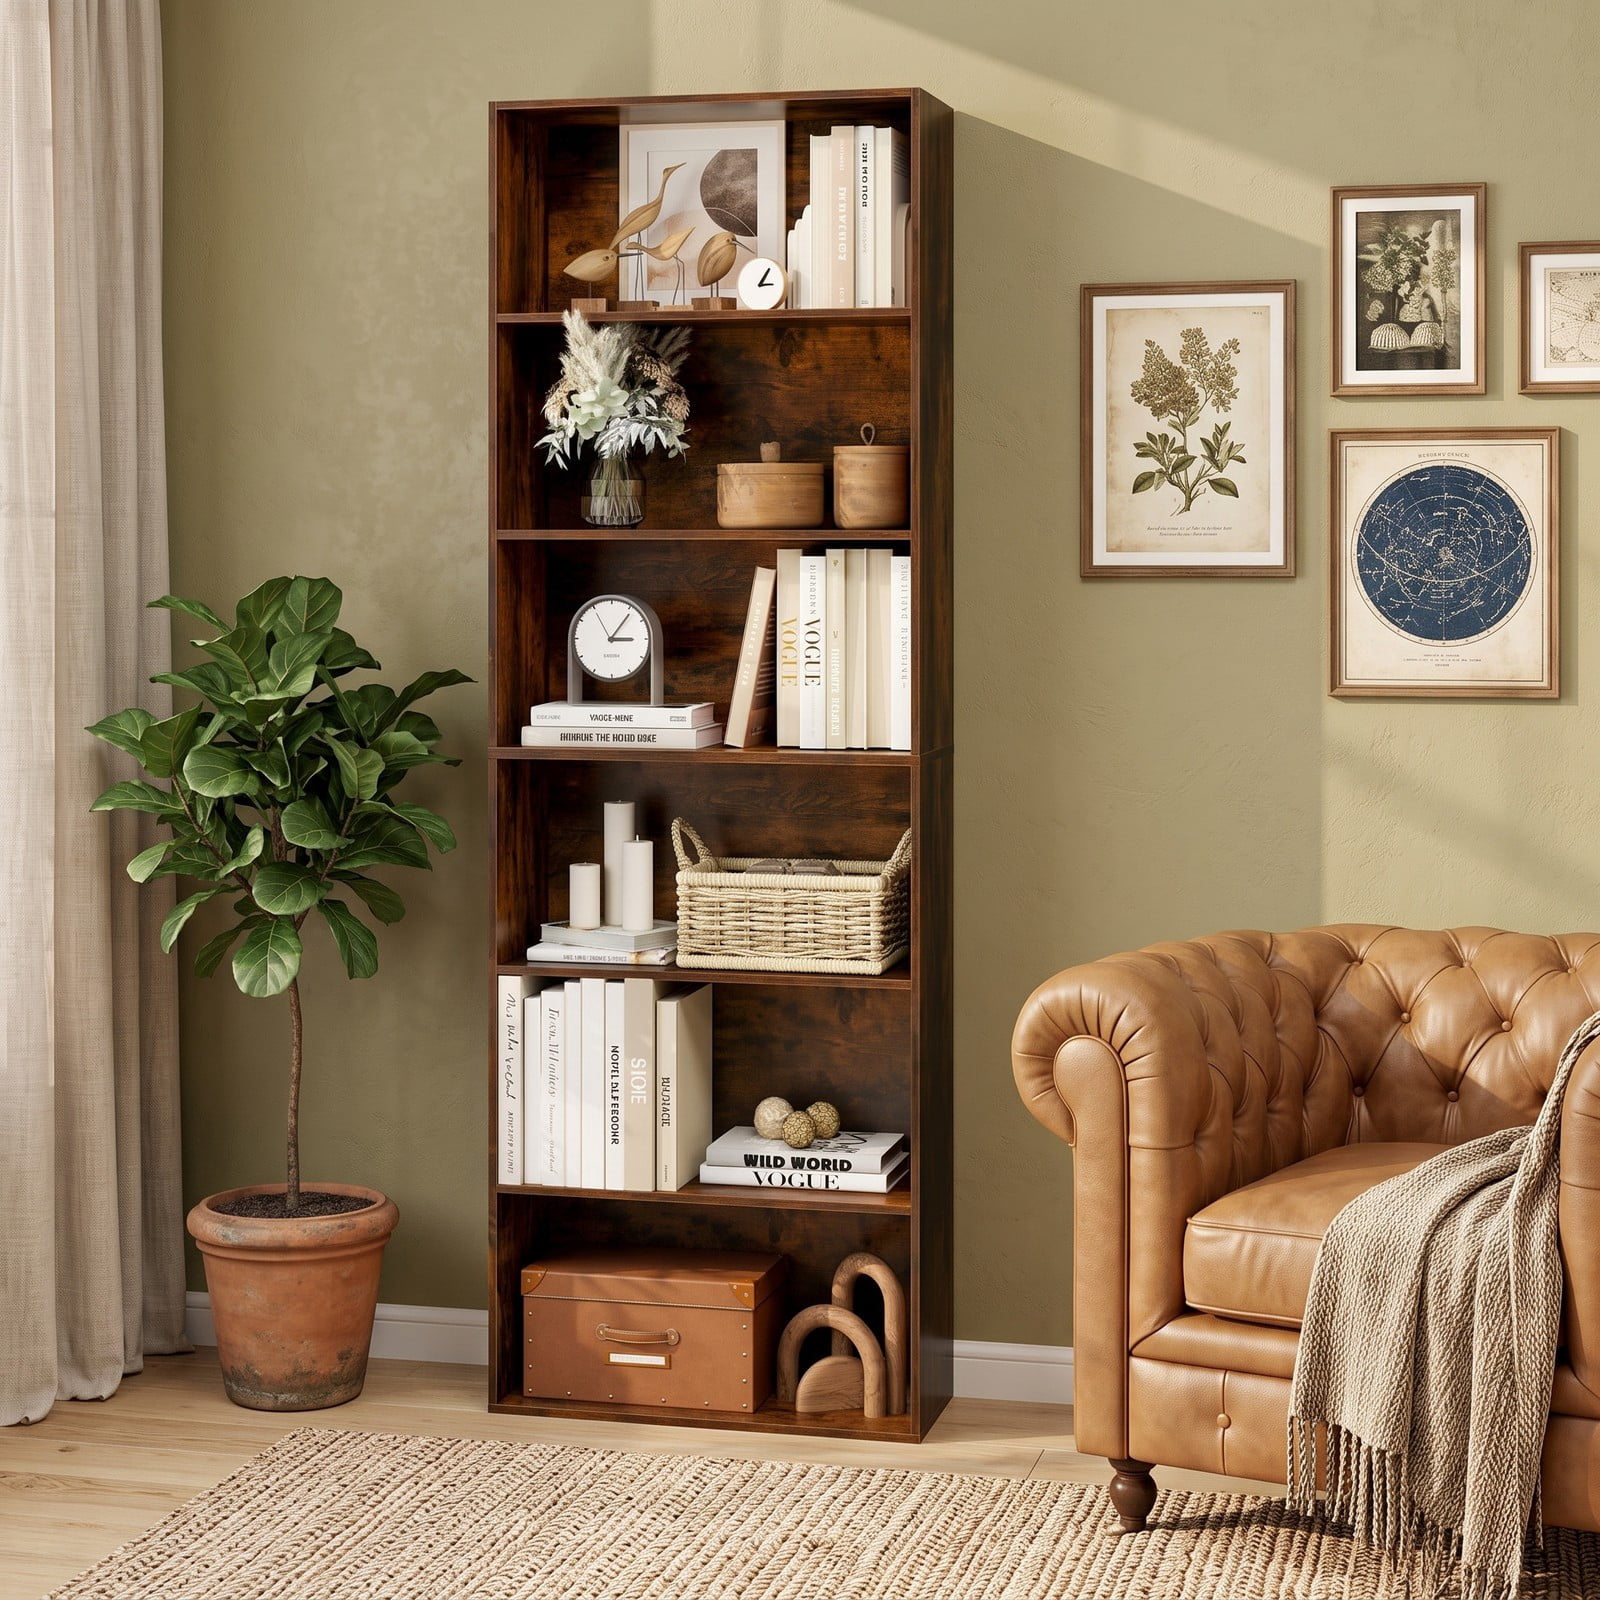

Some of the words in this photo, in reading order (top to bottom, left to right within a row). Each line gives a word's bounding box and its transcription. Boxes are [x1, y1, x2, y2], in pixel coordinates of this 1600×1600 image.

[781, 617, 798, 688] VOGUE
[804, 618, 821, 687] VOGUE
[595, 732, 610, 742] THE
[743, 1153, 786, 1169] WILD
[790, 1156, 853, 1172] WORLD
[752, 1170, 840, 1189] VOGUE
